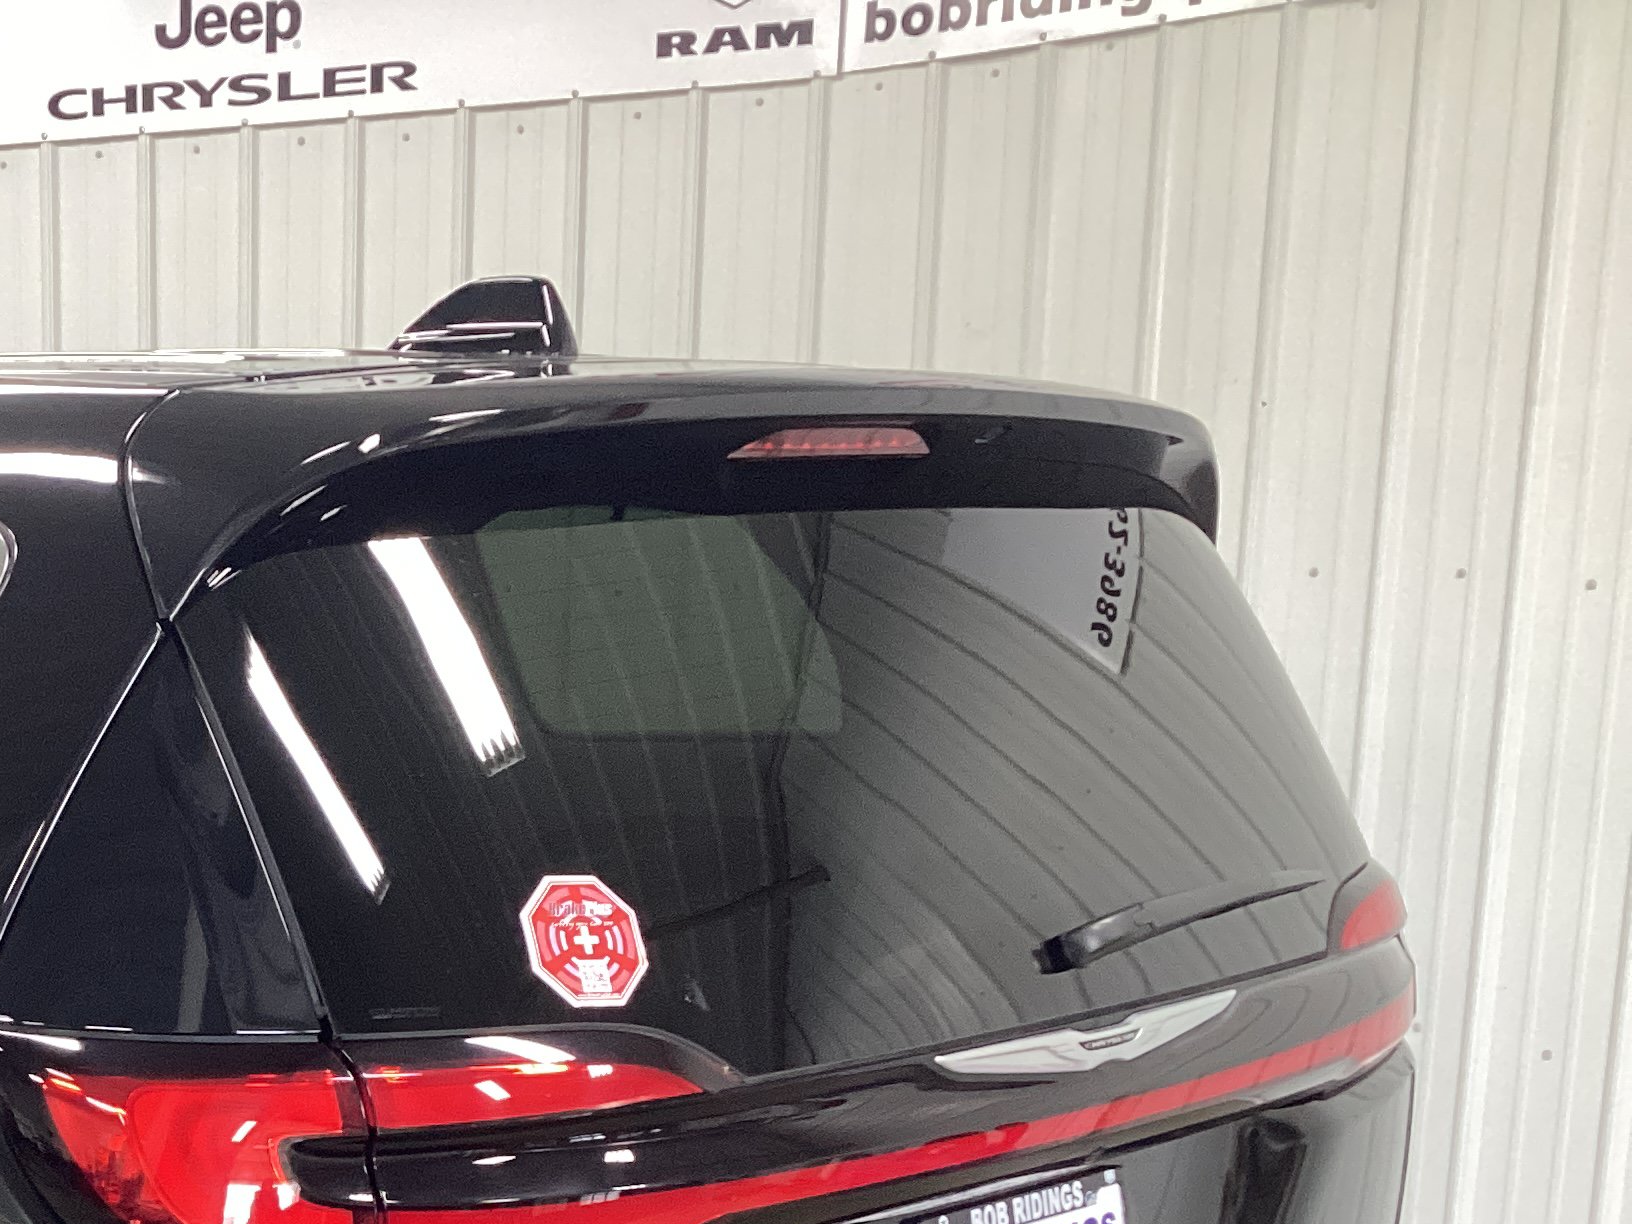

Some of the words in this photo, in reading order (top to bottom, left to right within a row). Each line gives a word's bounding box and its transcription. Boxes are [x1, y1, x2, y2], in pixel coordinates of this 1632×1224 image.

[155, 0, 302, 54] Jeep
[656, 18, 814, 59] RAM
[47, 60, 419, 120] CHRYSLER
[1012, 1181, 1084, 1224] RIDINGS
